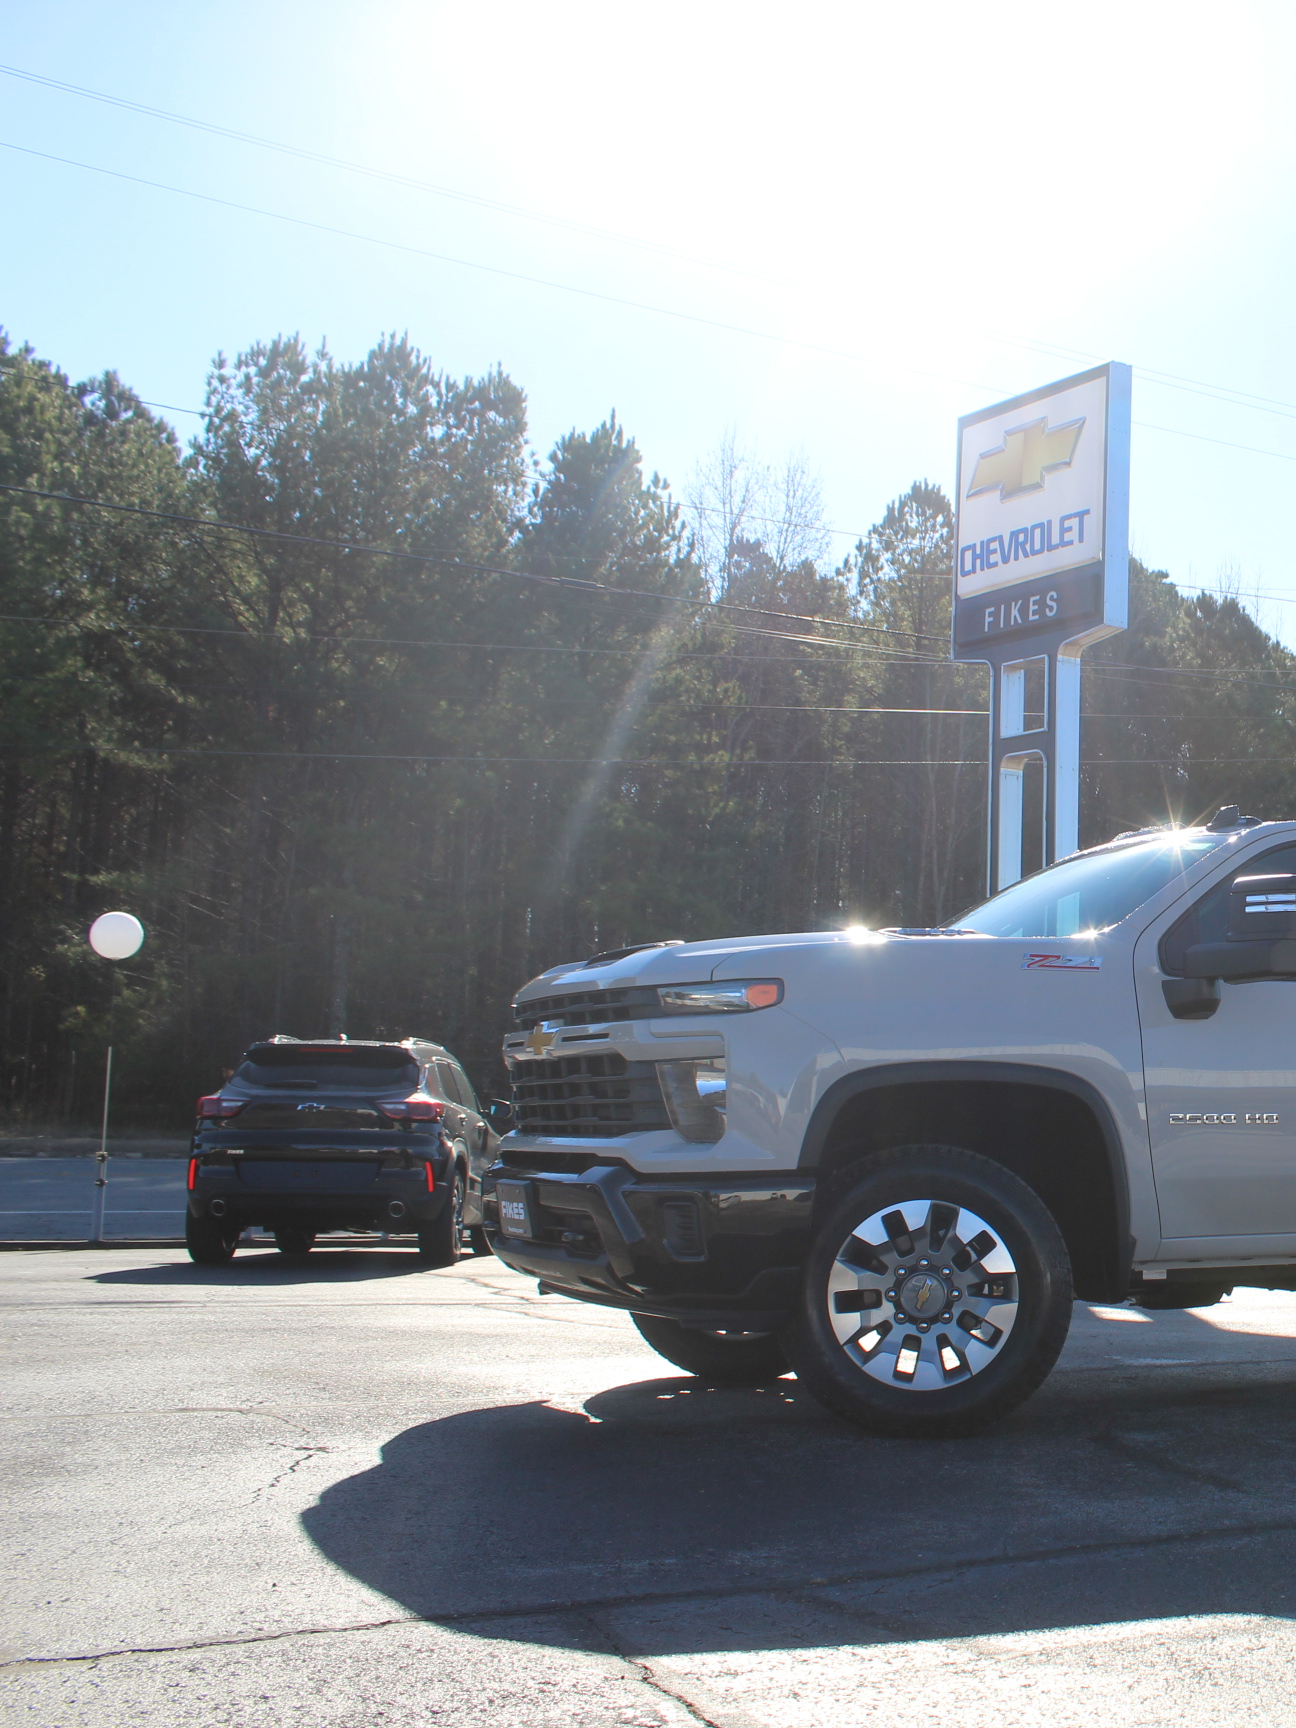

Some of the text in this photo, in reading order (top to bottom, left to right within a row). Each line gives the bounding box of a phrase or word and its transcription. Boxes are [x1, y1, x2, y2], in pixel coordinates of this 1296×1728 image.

[960, 508, 1090, 576] CHEVROLET
[984, 590, 1058, 632] FIKES
[1169, 1113, 1279, 1125] 2500 HD
[502, 1200, 525, 1219] FIKES
